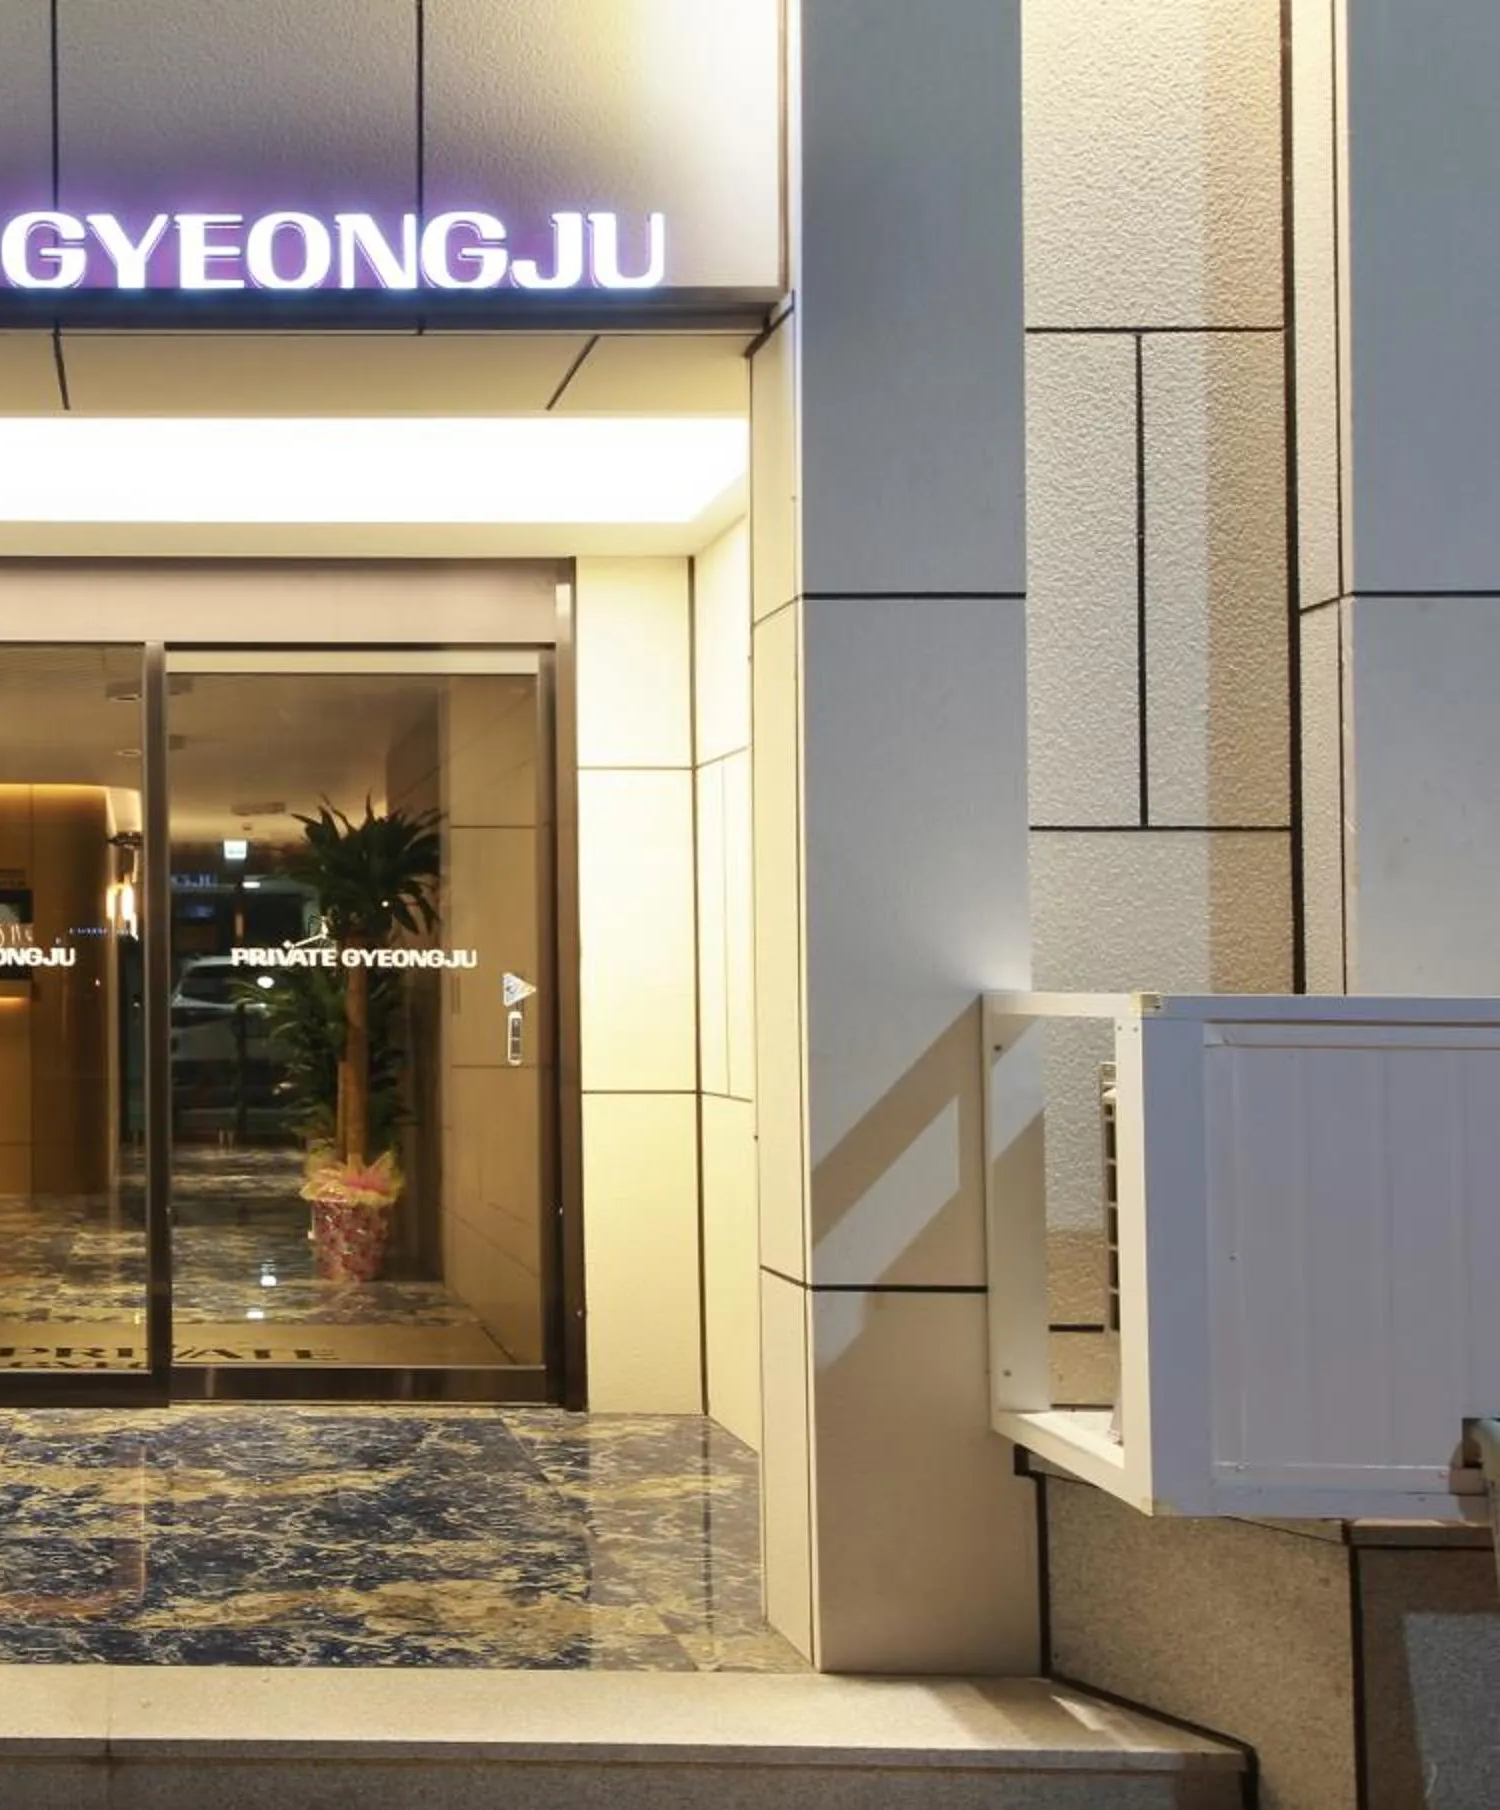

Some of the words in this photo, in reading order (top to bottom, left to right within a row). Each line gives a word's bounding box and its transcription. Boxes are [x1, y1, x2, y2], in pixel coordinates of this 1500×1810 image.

[1, 210, 666, 289] GYEONGJU
[231, 947, 338, 968] PRIVATE
[341, 948, 479, 968] GYEONGJU
